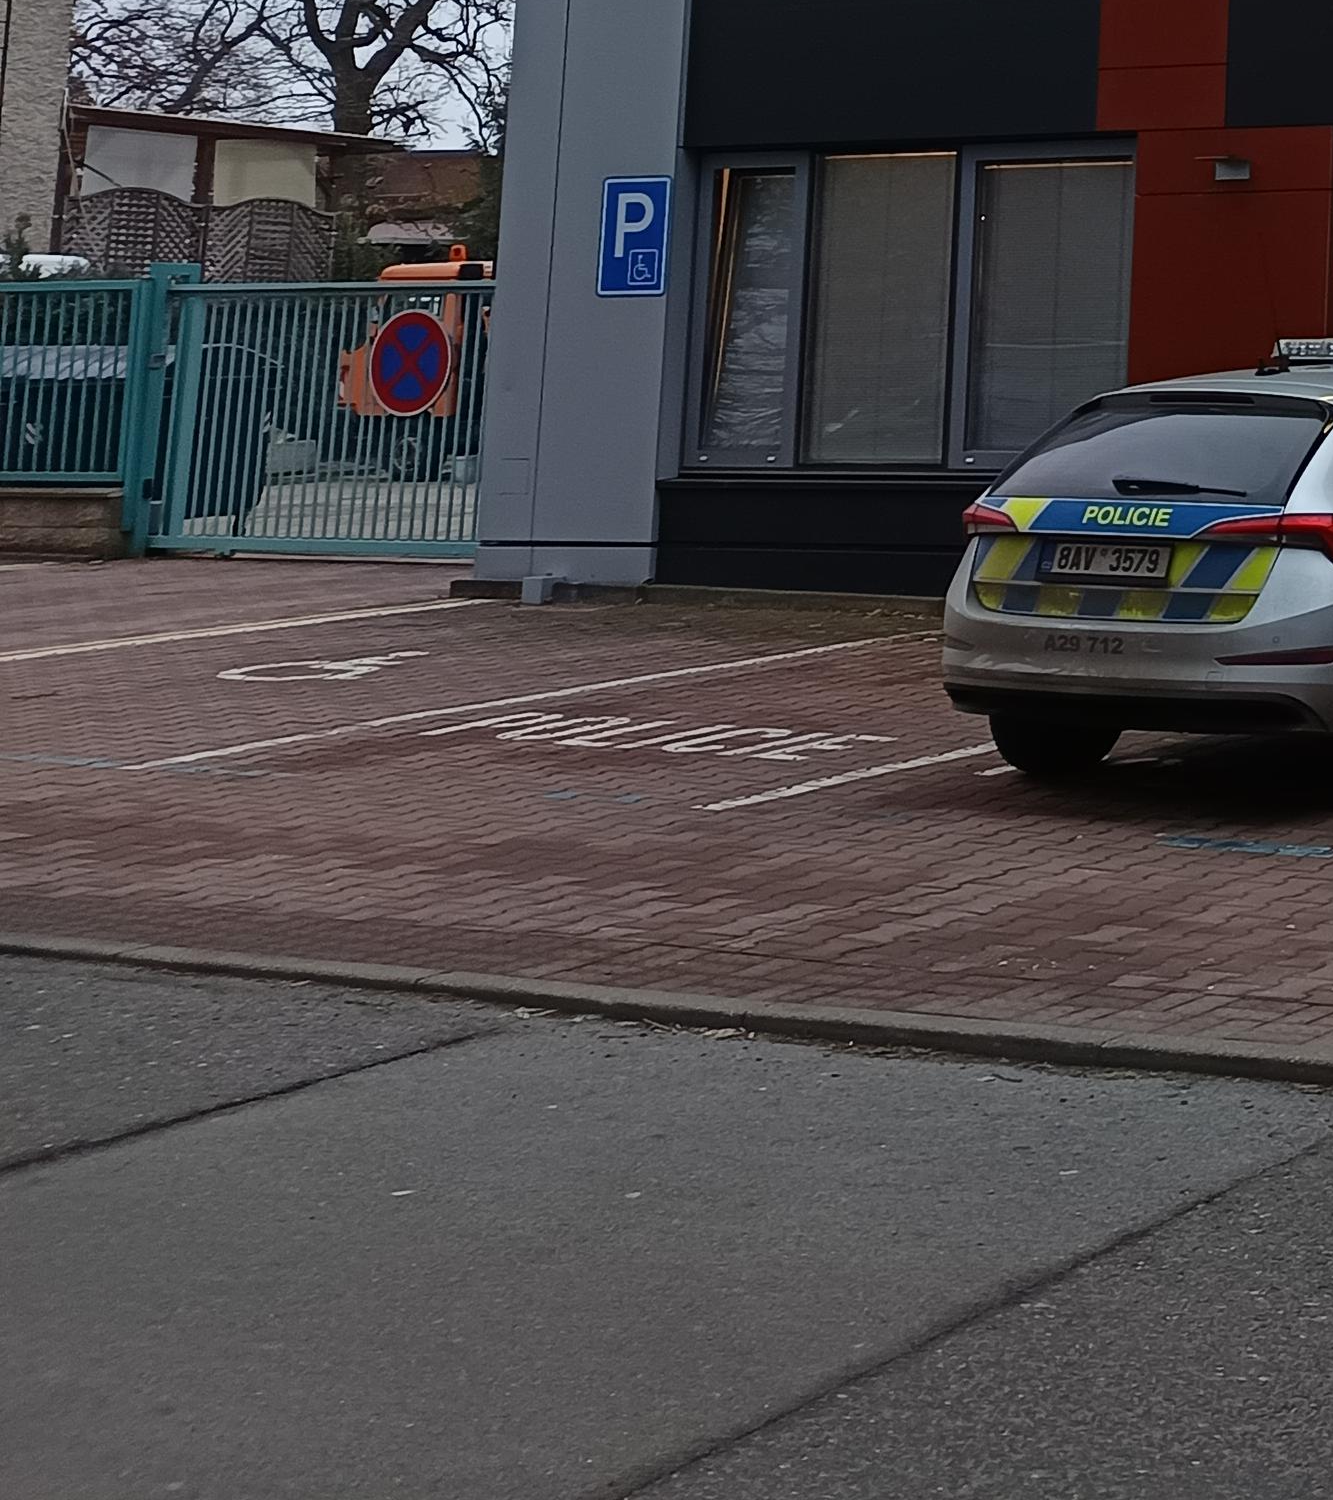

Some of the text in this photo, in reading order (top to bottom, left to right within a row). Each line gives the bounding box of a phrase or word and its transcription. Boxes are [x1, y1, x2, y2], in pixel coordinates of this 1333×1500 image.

[614, 193, 654, 257] P
[1082, 506, 1173, 526] POLICIE
[1057, 546, 1161, 573] 8AV 3579
[1044, 634, 1124, 654] A29 712
[418, 712, 898, 761] POLICIE
